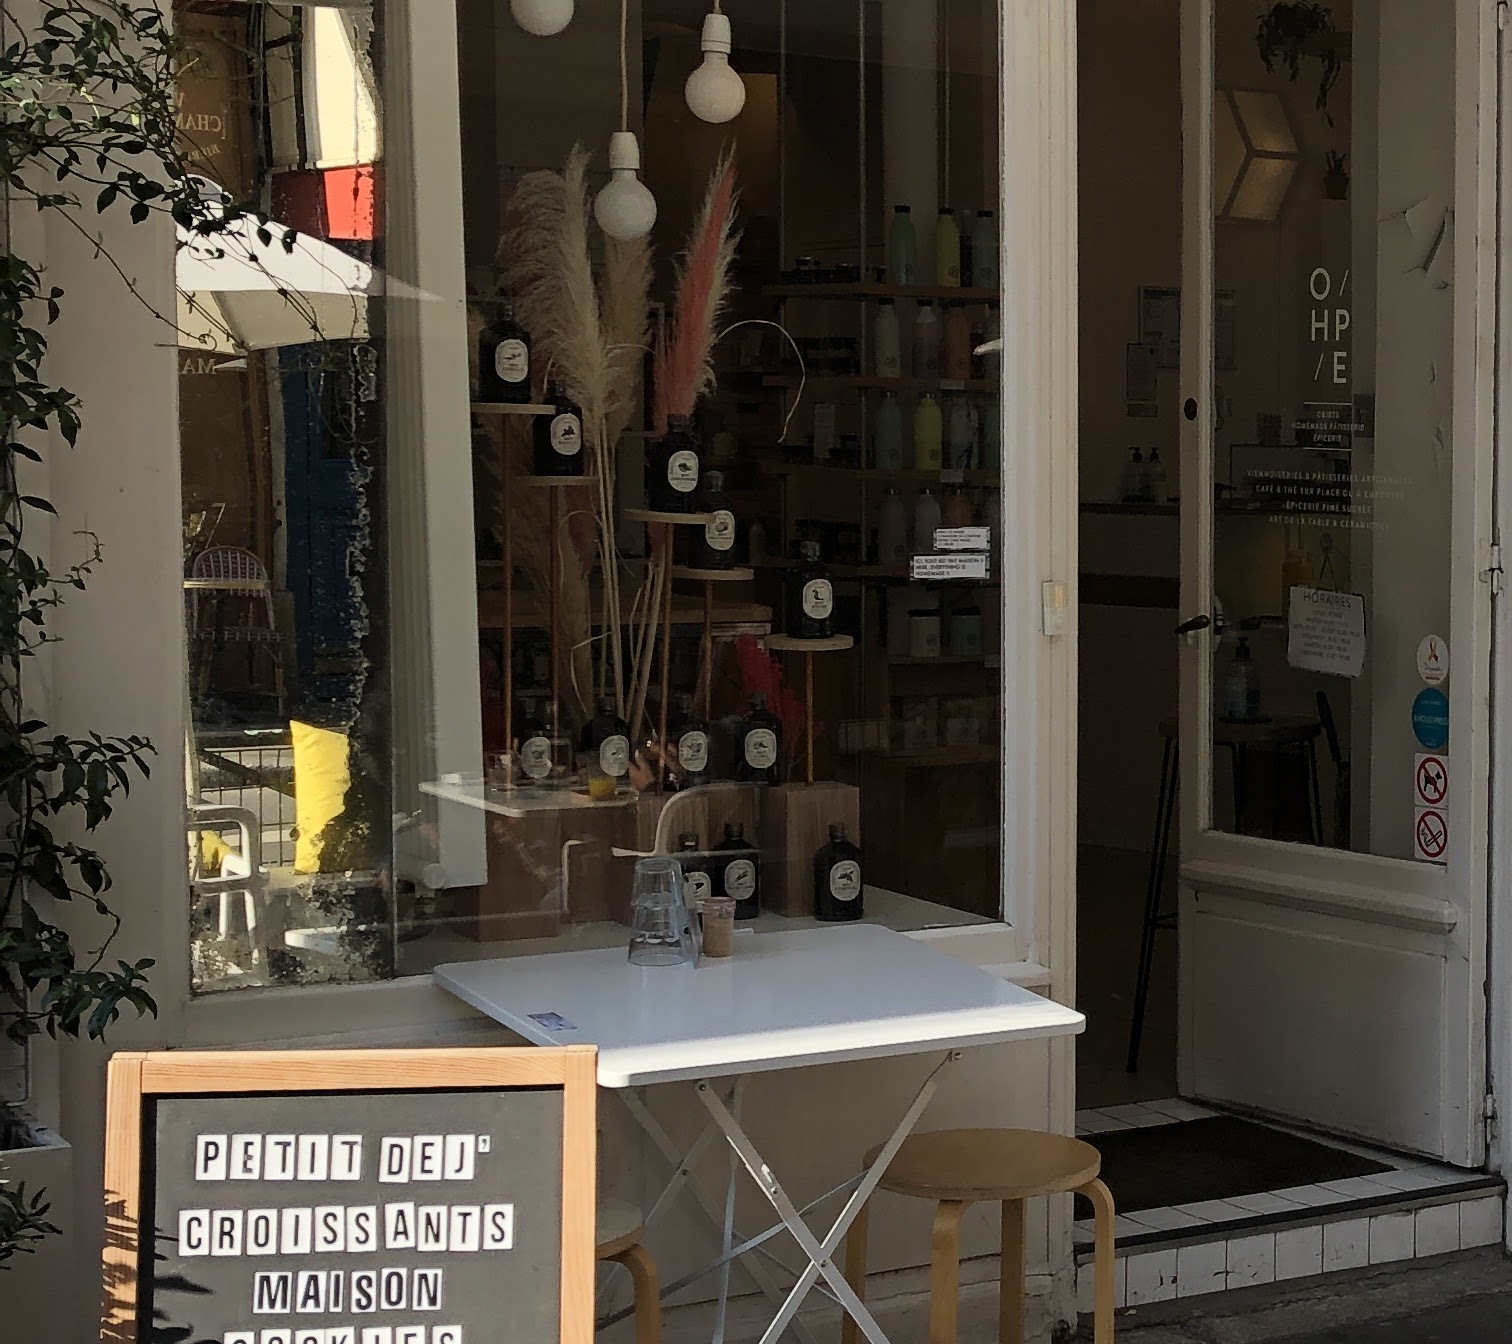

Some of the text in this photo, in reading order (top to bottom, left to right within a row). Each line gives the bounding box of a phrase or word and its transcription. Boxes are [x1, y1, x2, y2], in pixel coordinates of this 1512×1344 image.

[1303, 591, 1352, 609] HORAIRES
[202, 1139, 358, 1176] PETIT
[185, 1208, 508, 1250] CROISSANTS
[257, 1271, 439, 1310] MAISON
